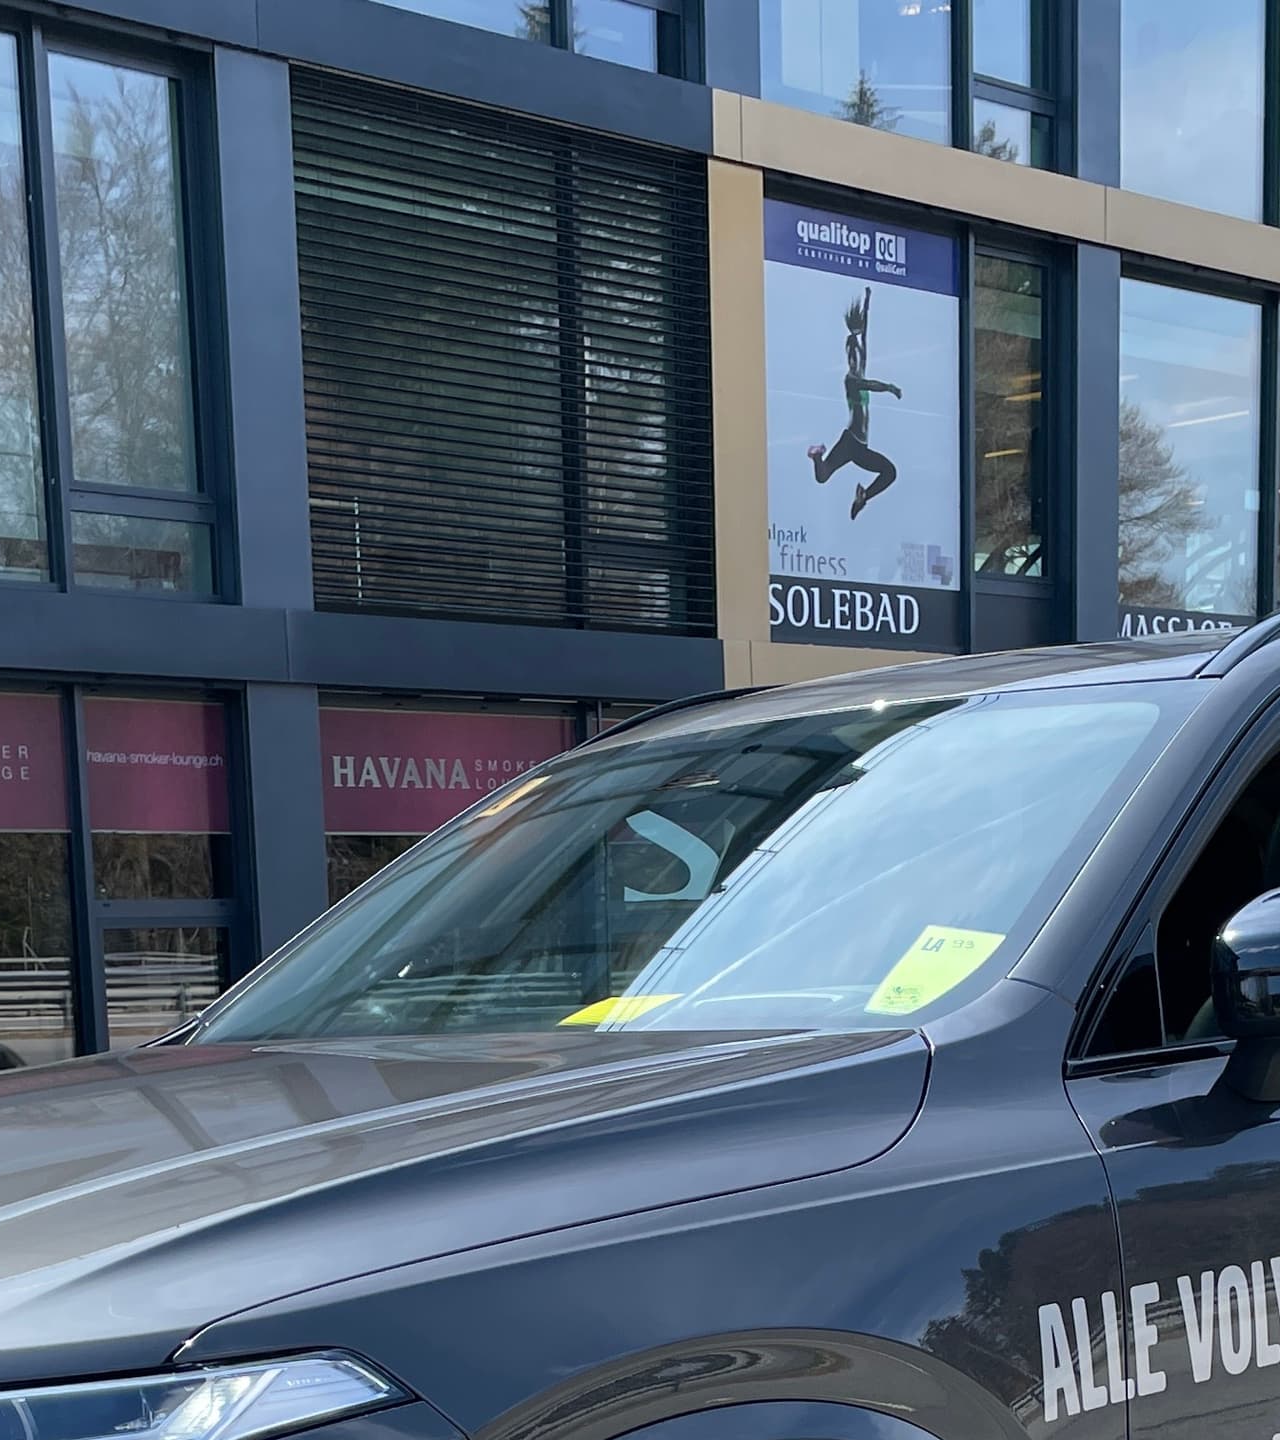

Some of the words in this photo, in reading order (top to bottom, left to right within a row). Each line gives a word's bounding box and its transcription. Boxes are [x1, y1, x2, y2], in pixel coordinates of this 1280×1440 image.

[797, 220, 871, 254] qualitop
[780, 544, 848, 577] fitness
[769, 582, 920, 635] SOLEBAD
[86, 749, 224, 769] havana-smoker-lounge.ch
[332, 754, 471, 790] HAVANA
[474, 758, 537, 773] SMOKE
[1038, 1280, 1168, 1423] ALLE
